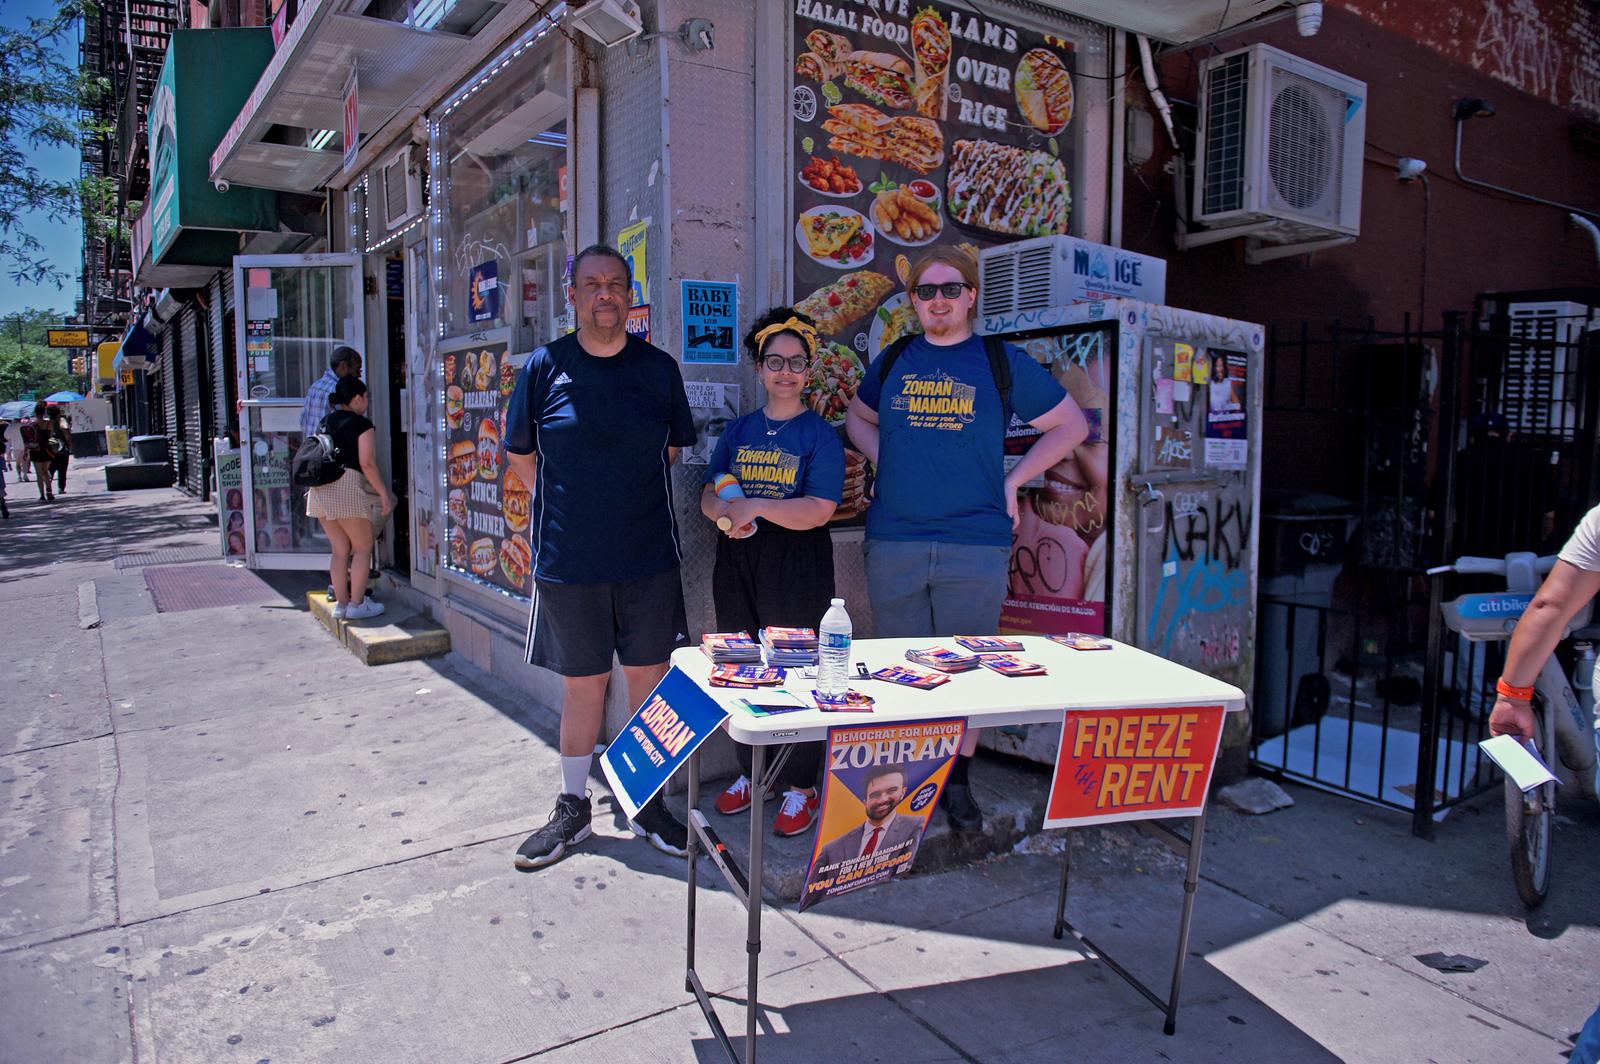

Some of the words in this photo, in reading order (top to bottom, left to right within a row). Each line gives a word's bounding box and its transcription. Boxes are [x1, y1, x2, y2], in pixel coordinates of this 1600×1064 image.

[796, 3, 857, 31] HALAL
[861, 14, 909, 43] FOOD
[951, 11, 1018, 50] LAMB
[956, 57, 1011, 91] OVER
[958, 99, 1008, 131] RICE
[1114, 259, 1142, 286] ICE
[688, 288, 732, 303] BABY
[689, 302, 732, 317] ROSE
[464, 390, 497, 409] BREAKFAST
[902, 381, 953, 396] ZOHRAN
[908, 396, 974, 414] MAMDANI
[937, 422, 964, 430] AFFORD
[221, 458, 242, 474] MODE
[736, 448, 781, 465] ZOHRAN
[741, 465, 797, 485] MAMDANI
[471, 481, 497, 505] LUNCH
[762, 490, 785, 498] AFFORD
[474, 511, 505, 537] DINNER
[1478, 600, 1500, 612] citi
[640, 693, 697, 758] ZOHRAN
[834, 729, 896, 743] DEMOCRAT
[899, 728, 920, 738] FOR
[922, 724, 961, 736] MAYOR
[1072, 713, 1199, 759] FREEZE
[640, 737, 656, 757] YORK
[650, 747, 666, 768] CITY
[831, 735, 962, 770] ZOHRAN
[1074, 763, 1097, 797] THE
[1095, 763, 1204, 810] RENT
[808, 878, 834, 893] YOU
[836, 870, 864, 885] CAN
[864, 851, 913, 876] AFFORD
[819, 862, 840, 874] RANK
[840, 854, 871, 868] ZOHRAN
[839, 865, 852, 876] FOR
[858, 860, 874, 871] NEW
[874, 853, 891, 865] YORK
